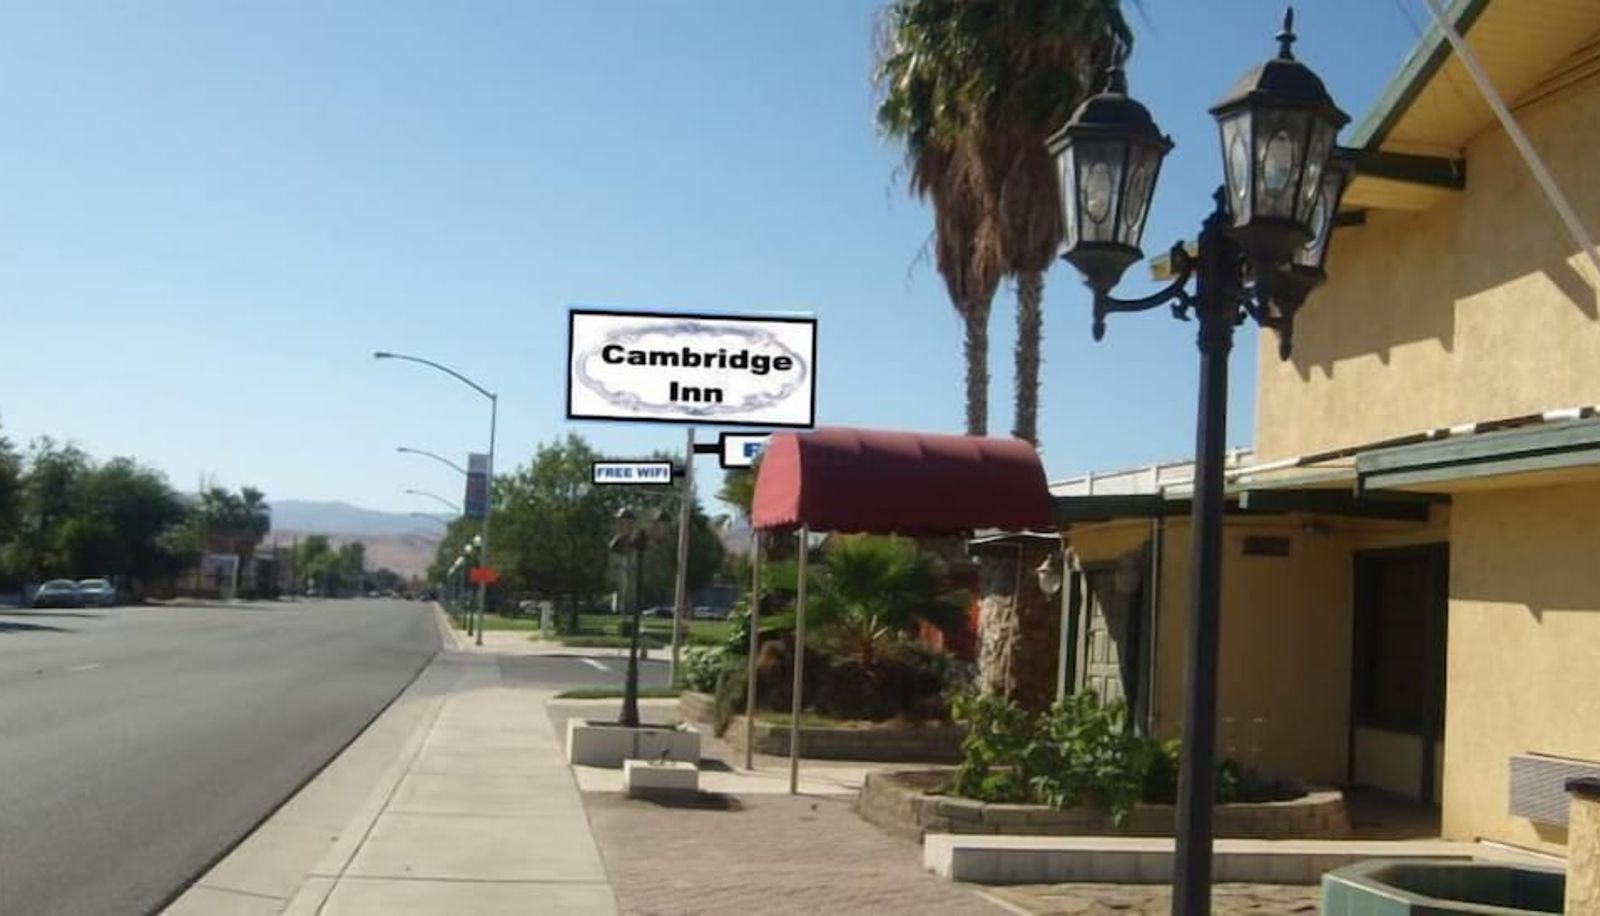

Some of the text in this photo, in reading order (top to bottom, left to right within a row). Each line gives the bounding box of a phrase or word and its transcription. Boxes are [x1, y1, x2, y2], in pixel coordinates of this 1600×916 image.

[601, 344, 793, 375] Cambridge
[669, 381, 724, 403] Inn
[597, 467, 633, 479] FREE
